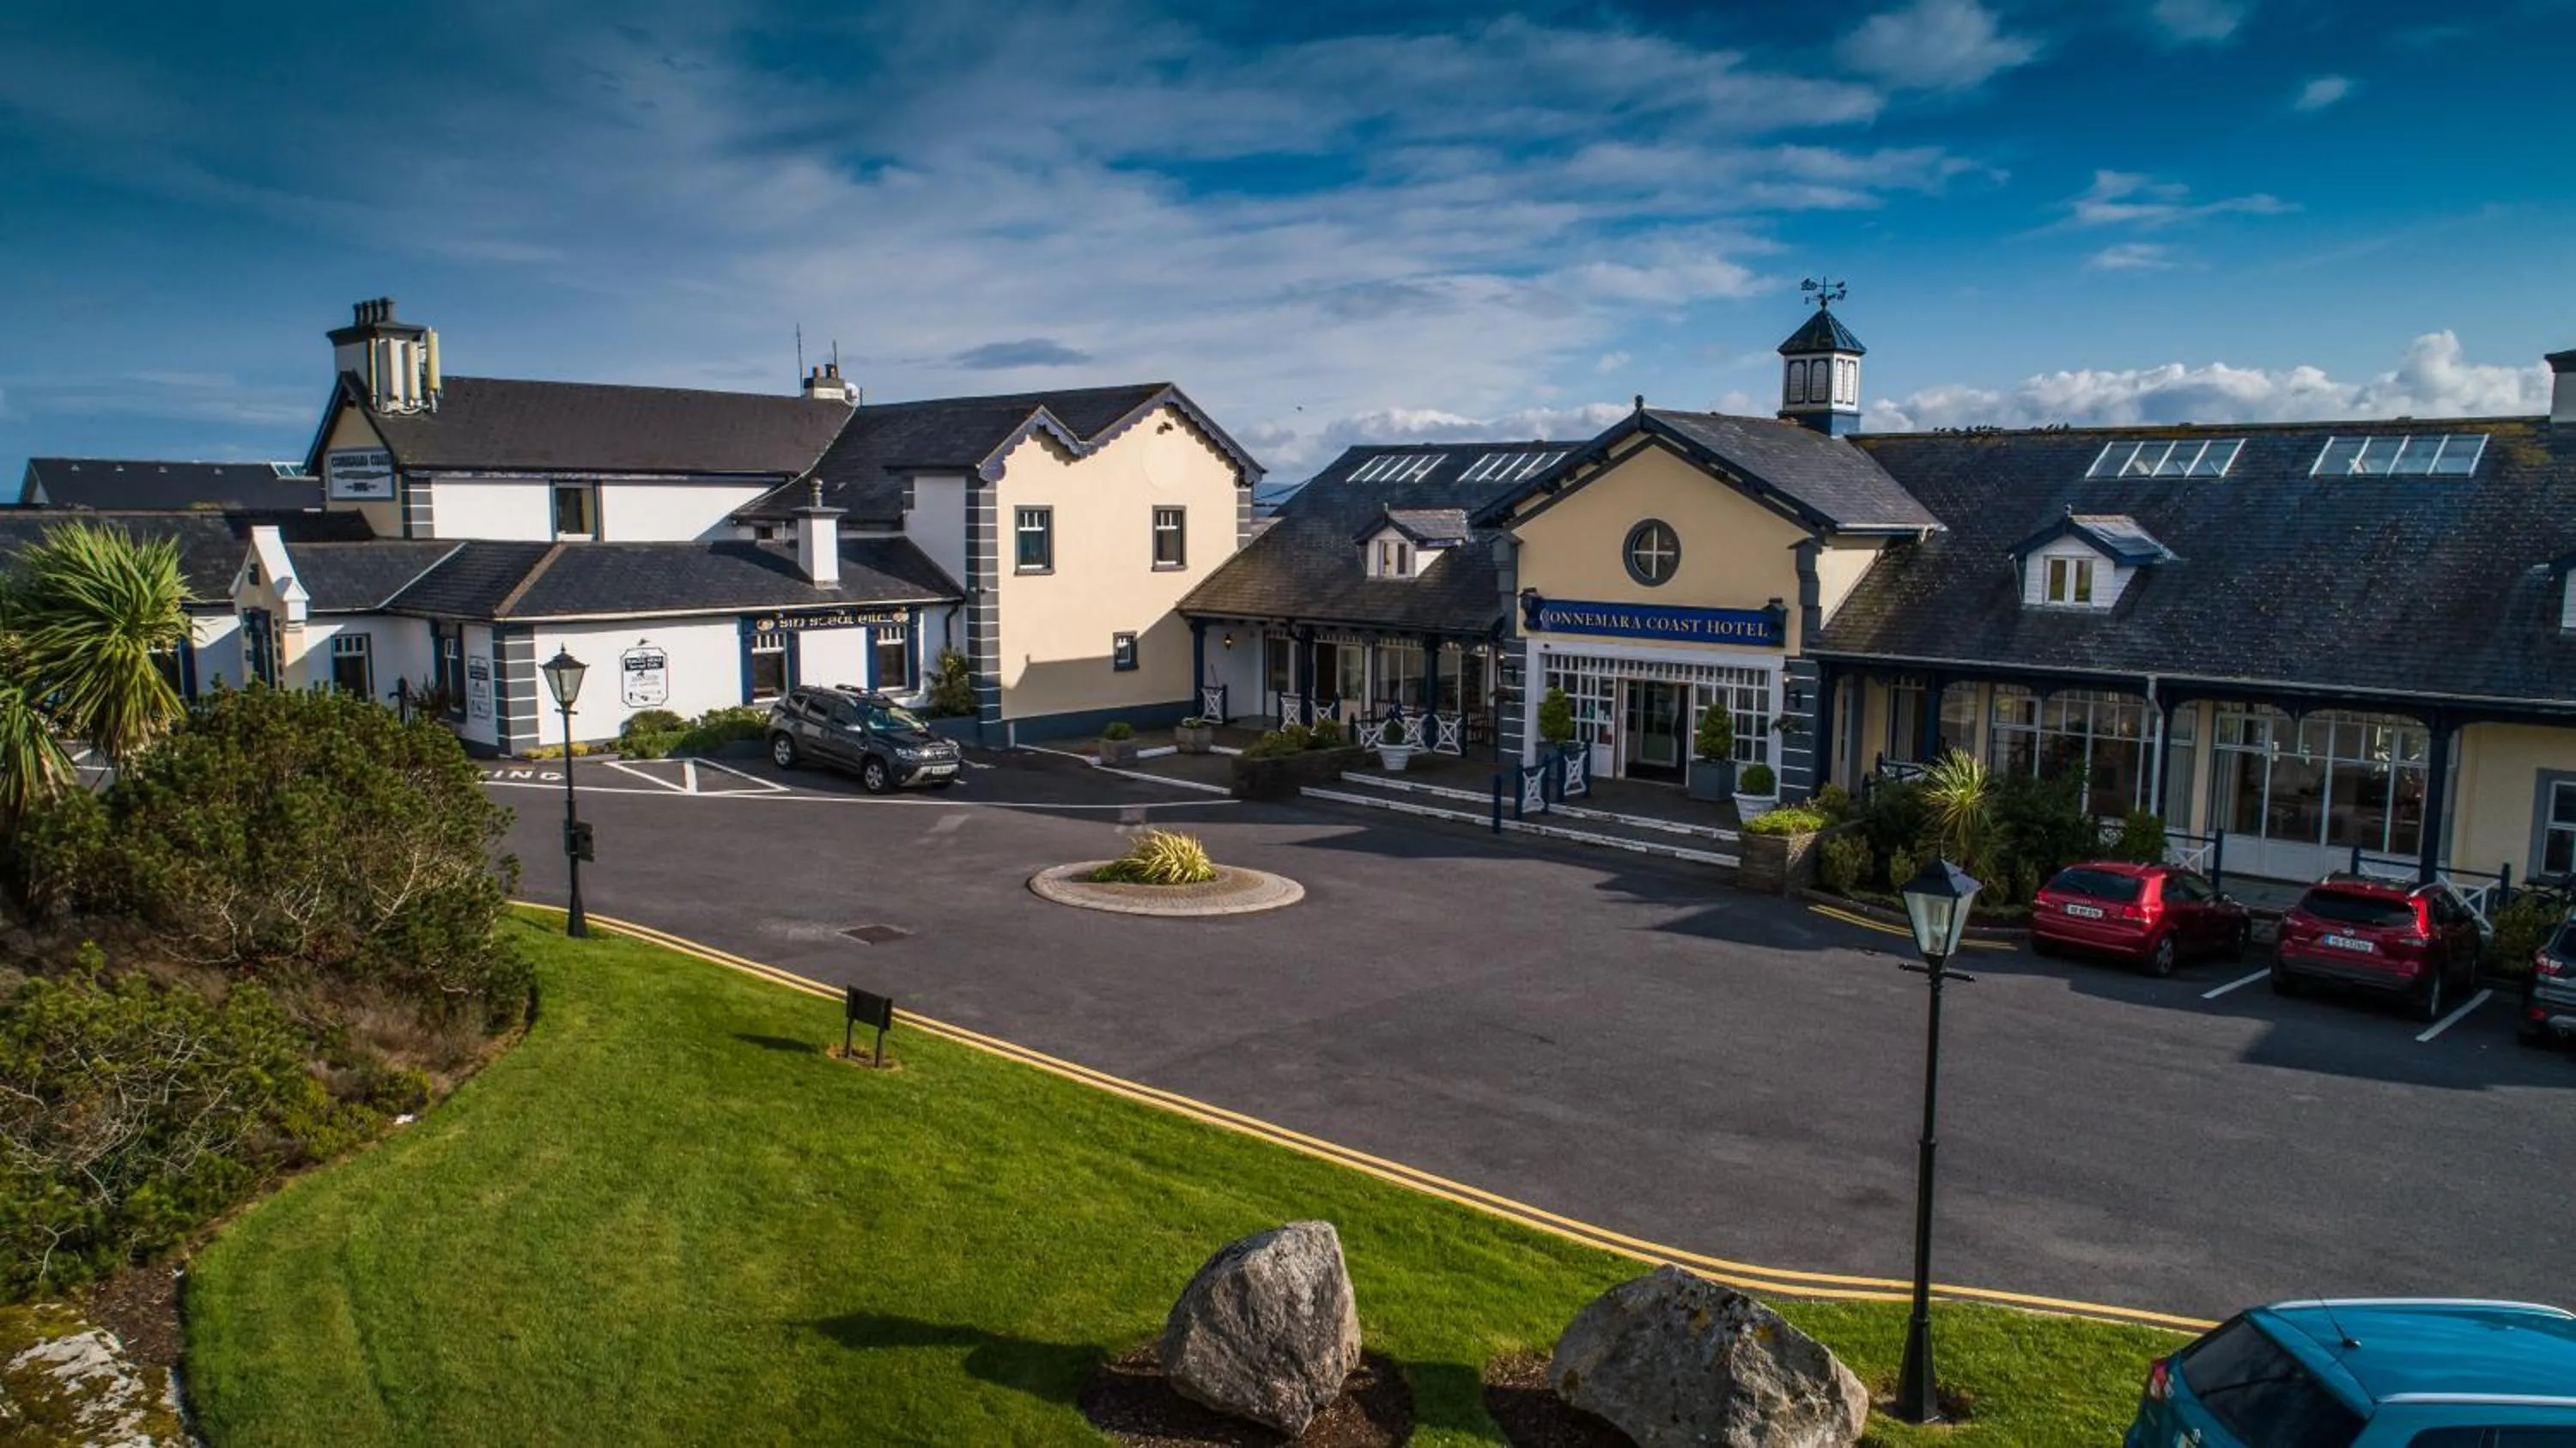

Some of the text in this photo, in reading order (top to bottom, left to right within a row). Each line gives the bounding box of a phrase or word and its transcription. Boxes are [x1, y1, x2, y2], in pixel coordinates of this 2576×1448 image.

[1539, 608, 1768, 637] CONNEMARA COAST HOTEL
